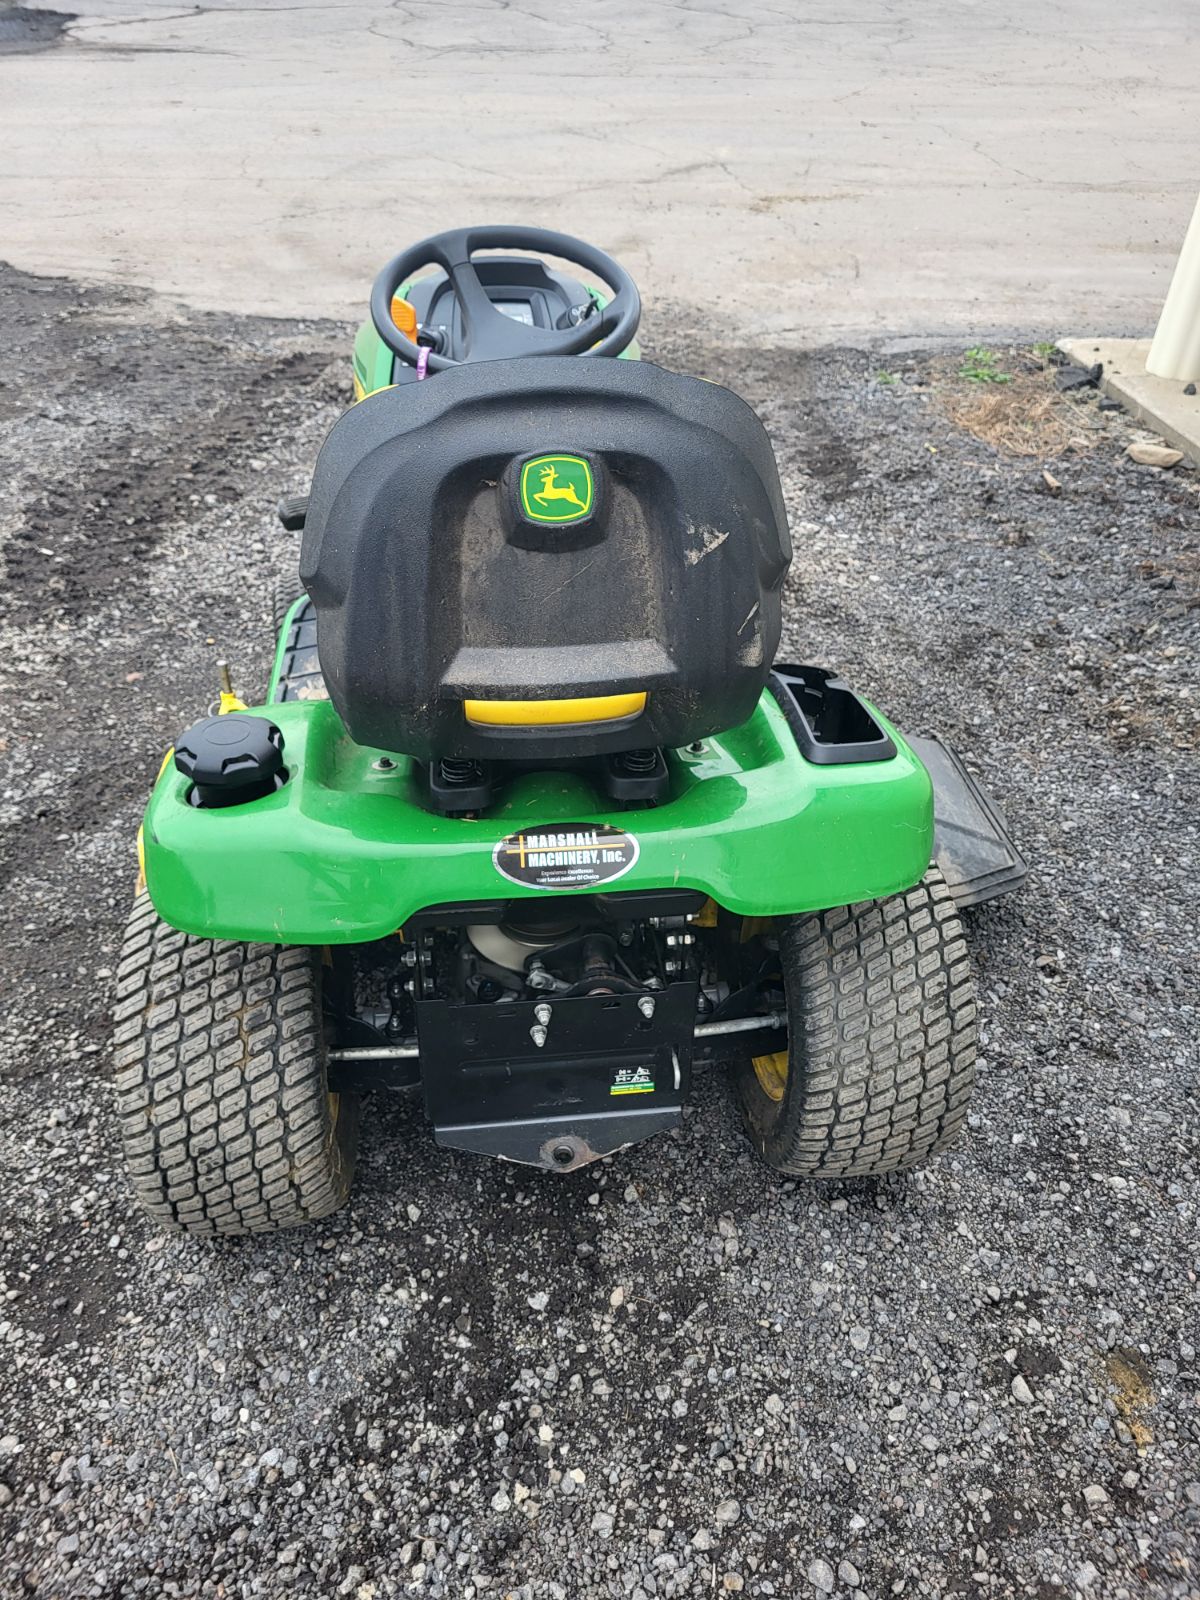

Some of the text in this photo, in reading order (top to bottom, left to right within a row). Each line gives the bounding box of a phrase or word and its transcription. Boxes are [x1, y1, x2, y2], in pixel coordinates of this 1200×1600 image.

[527, 831, 599, 848] MARSHALL
[528, 849, 626, 867] MACHINERY, Inc.
